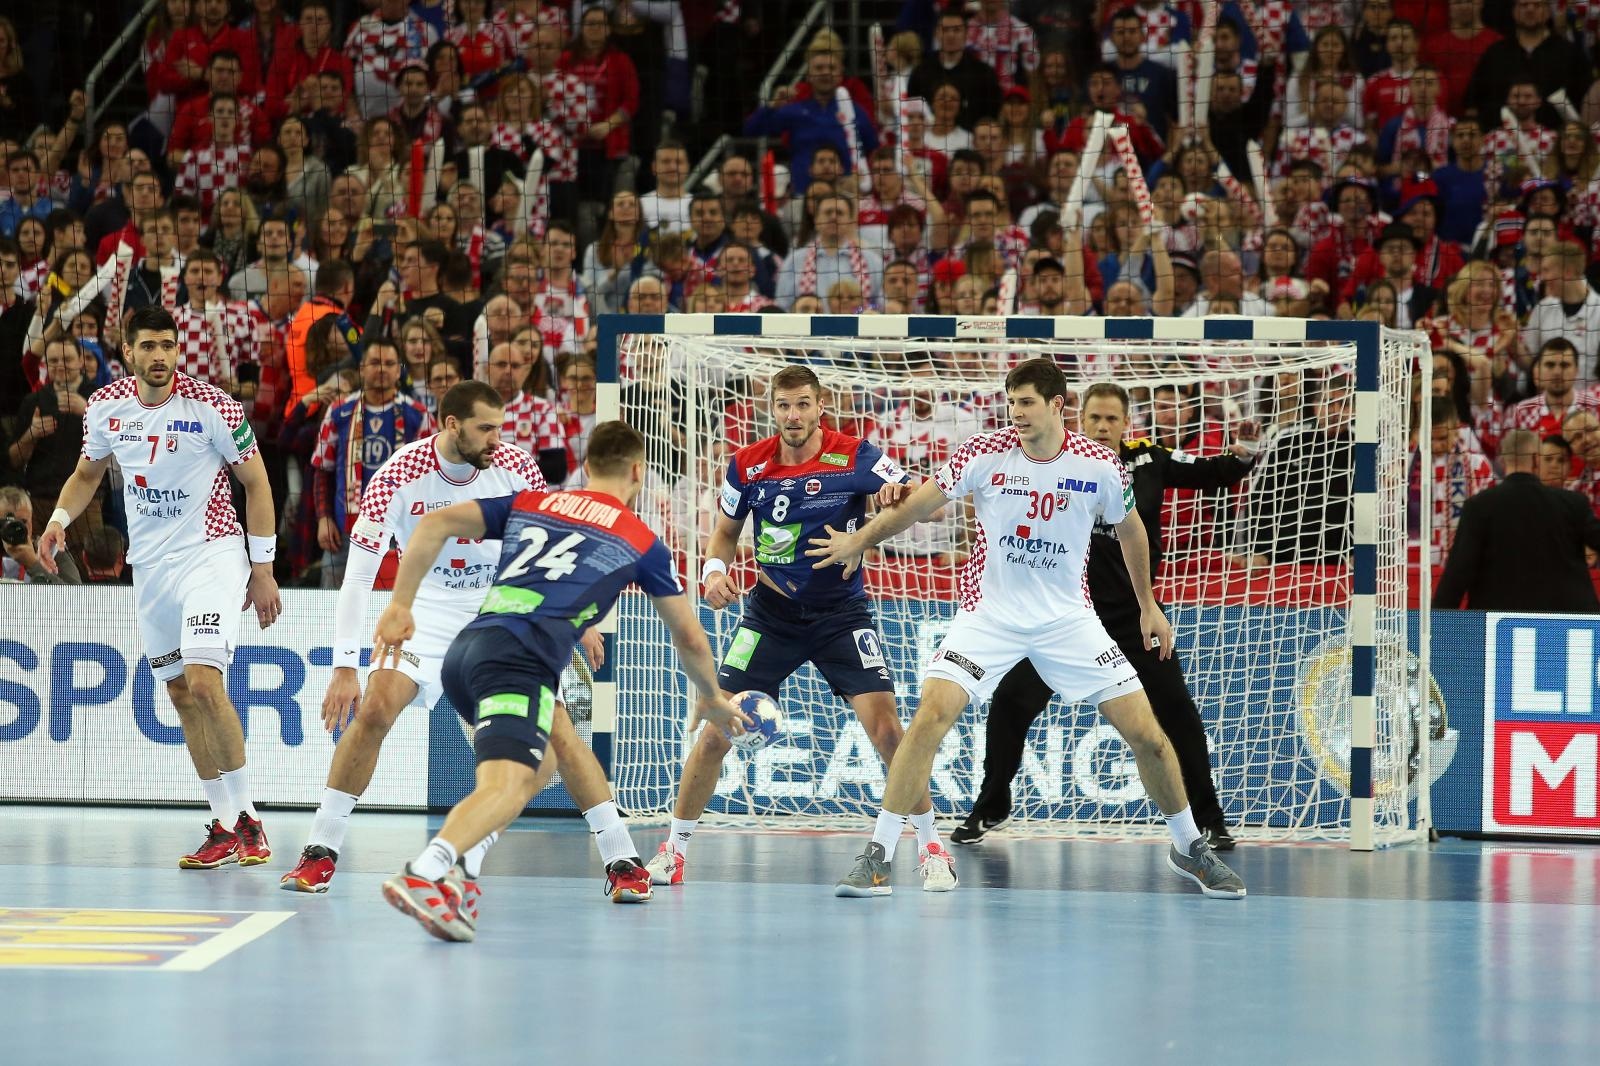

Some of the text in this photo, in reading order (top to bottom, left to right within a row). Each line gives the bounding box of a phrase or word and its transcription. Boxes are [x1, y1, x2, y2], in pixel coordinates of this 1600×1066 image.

[121, 421, 143, 431] HPB
[148, 436, 160, 464] 7
[365, 440, 382, 462] 19
[1005, 476, 1030, 486] HPB
[128, 484, 190, 503] CROATIA
[772, 494, 791, 523] 8
[1026, 490, 1055, 521] 30
[500, 526, 586, 581] 24
[999, 535, 1069, 555] CROATIA
[433, 563, 499, 578] CROAT
[1006, 552, 1026, 565] Full
[1041, 558, 1058, 569] life
[186, 612, 221, 628] TELE2
[946, 651, 986, 677] PORSCHE
[1511, 626, 1600, 714] LI
[1508, 731, 1598, 818] M
